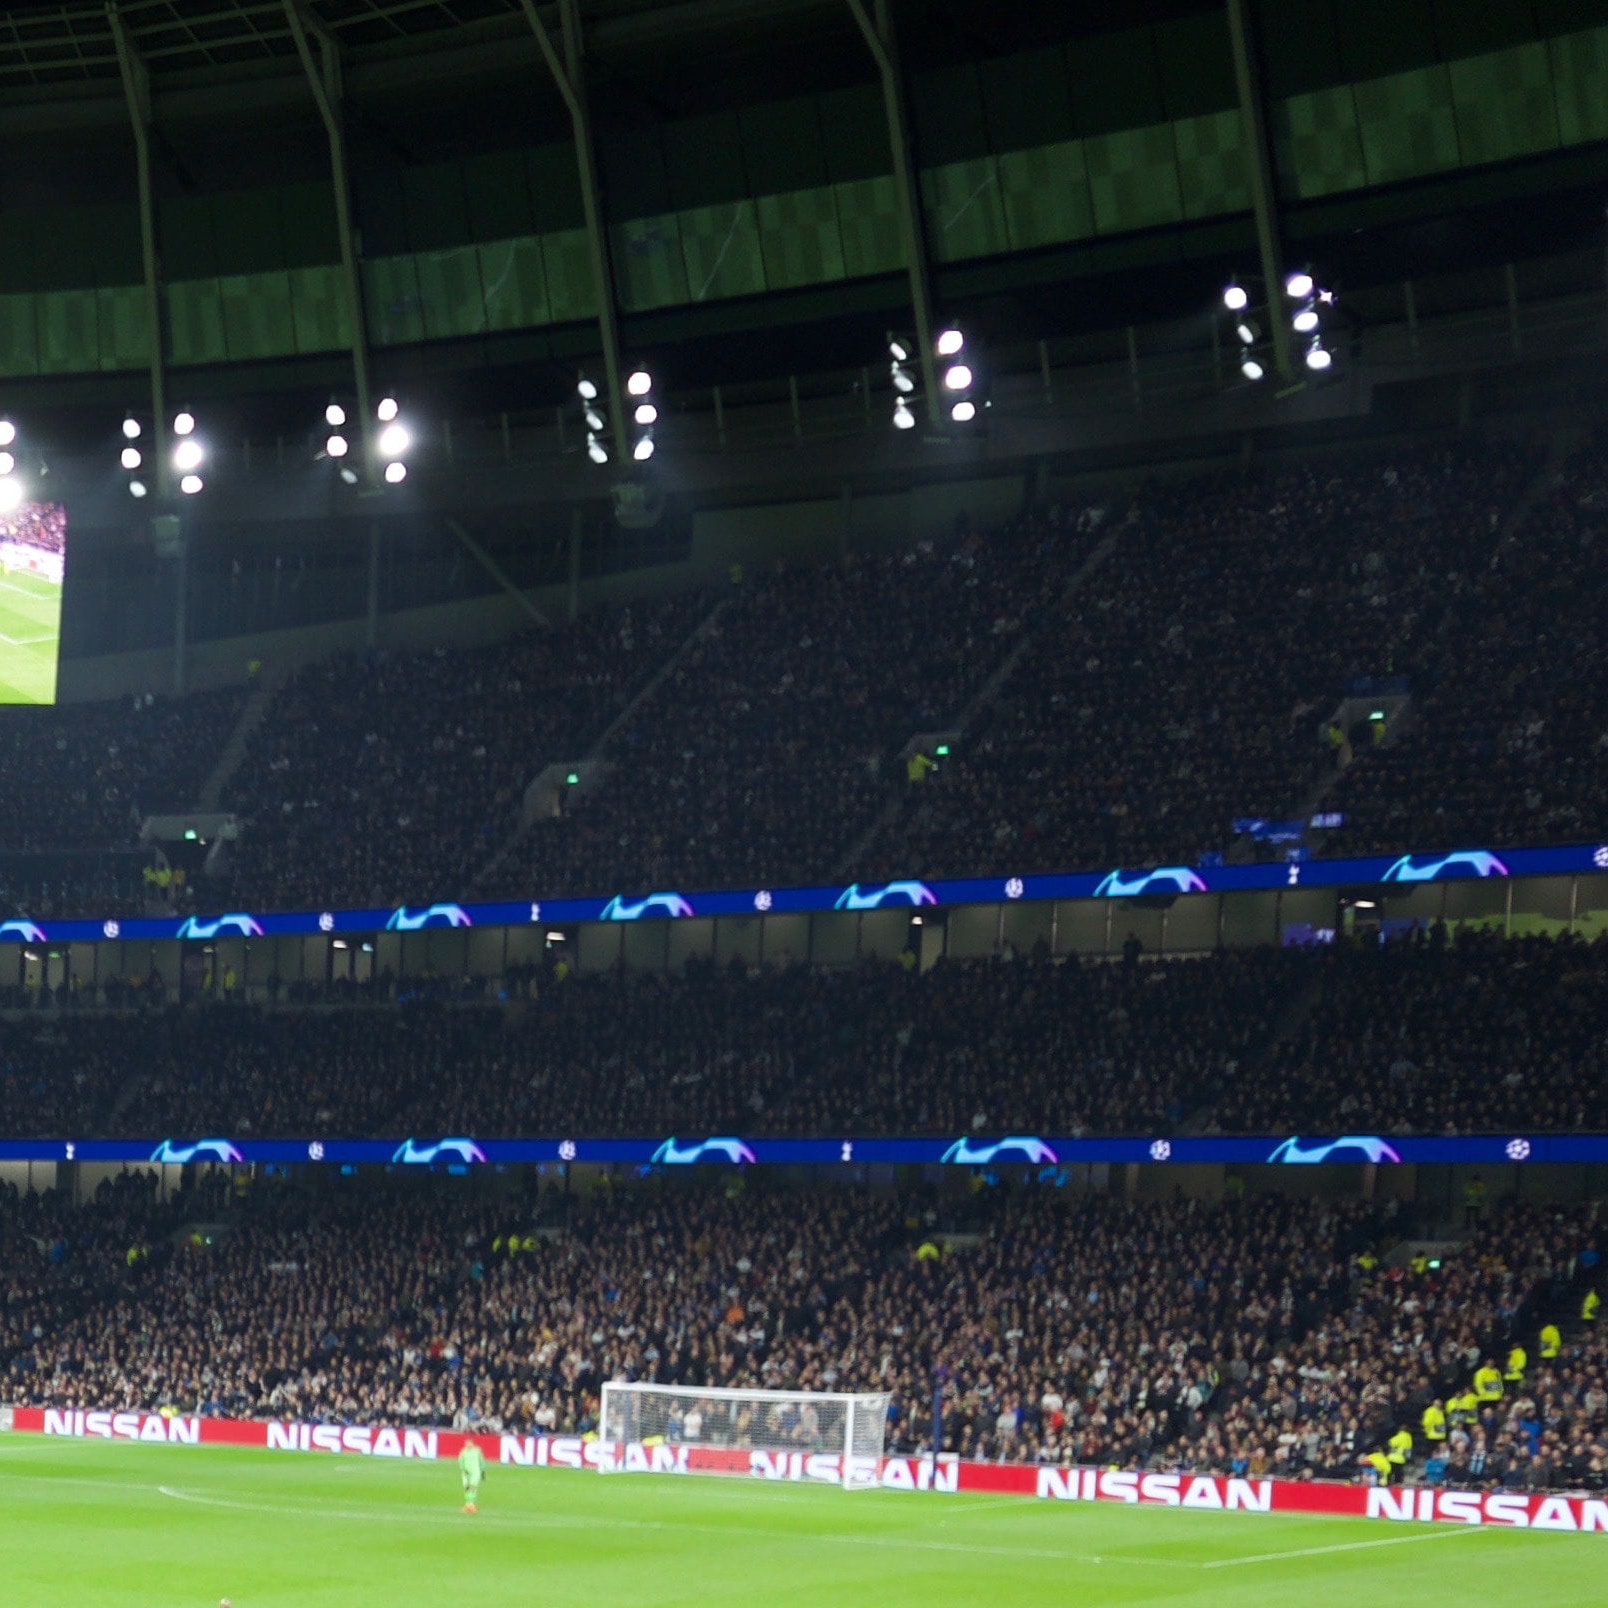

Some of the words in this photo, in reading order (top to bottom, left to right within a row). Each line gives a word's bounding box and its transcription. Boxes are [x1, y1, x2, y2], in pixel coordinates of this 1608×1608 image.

[44, 1408, 199, 1444] NISSAN
[266, 1421, 438, 1459] NISSAN
[500, 1434, 689, 1474] NISSAN
[749, 1449, 959, 1492] NISSAN
[1037, 1467, 1273, 1511] NISSAN
